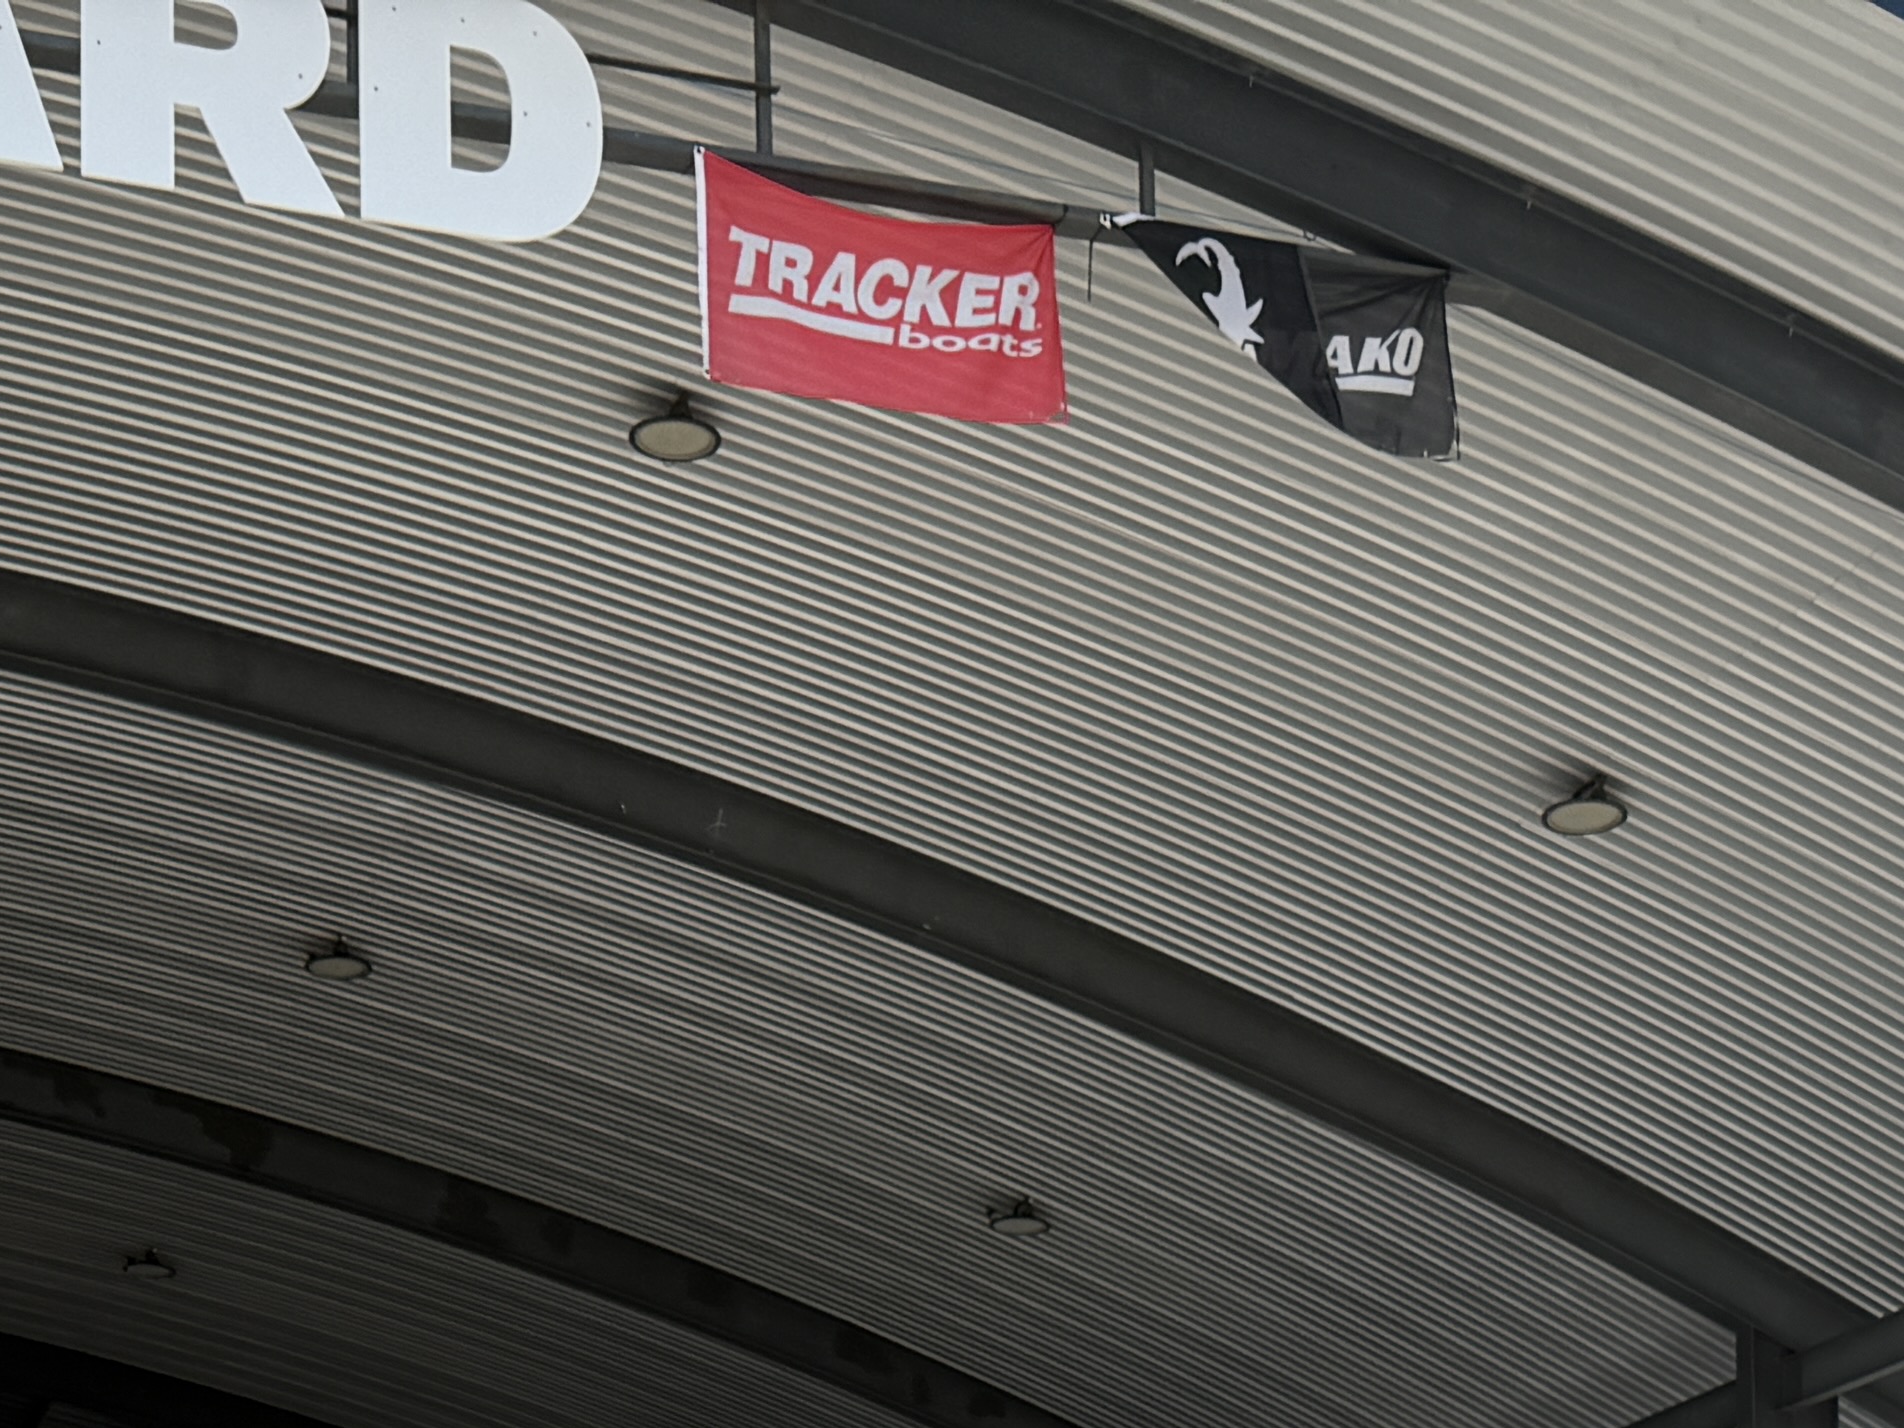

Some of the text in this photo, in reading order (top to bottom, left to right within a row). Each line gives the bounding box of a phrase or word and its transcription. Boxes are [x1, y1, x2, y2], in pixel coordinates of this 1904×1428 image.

[728, 225, 1041, 332] TRACKER
[898, 323, 1043, 357] boats
[1325, 326, 1424, 376] AKO
